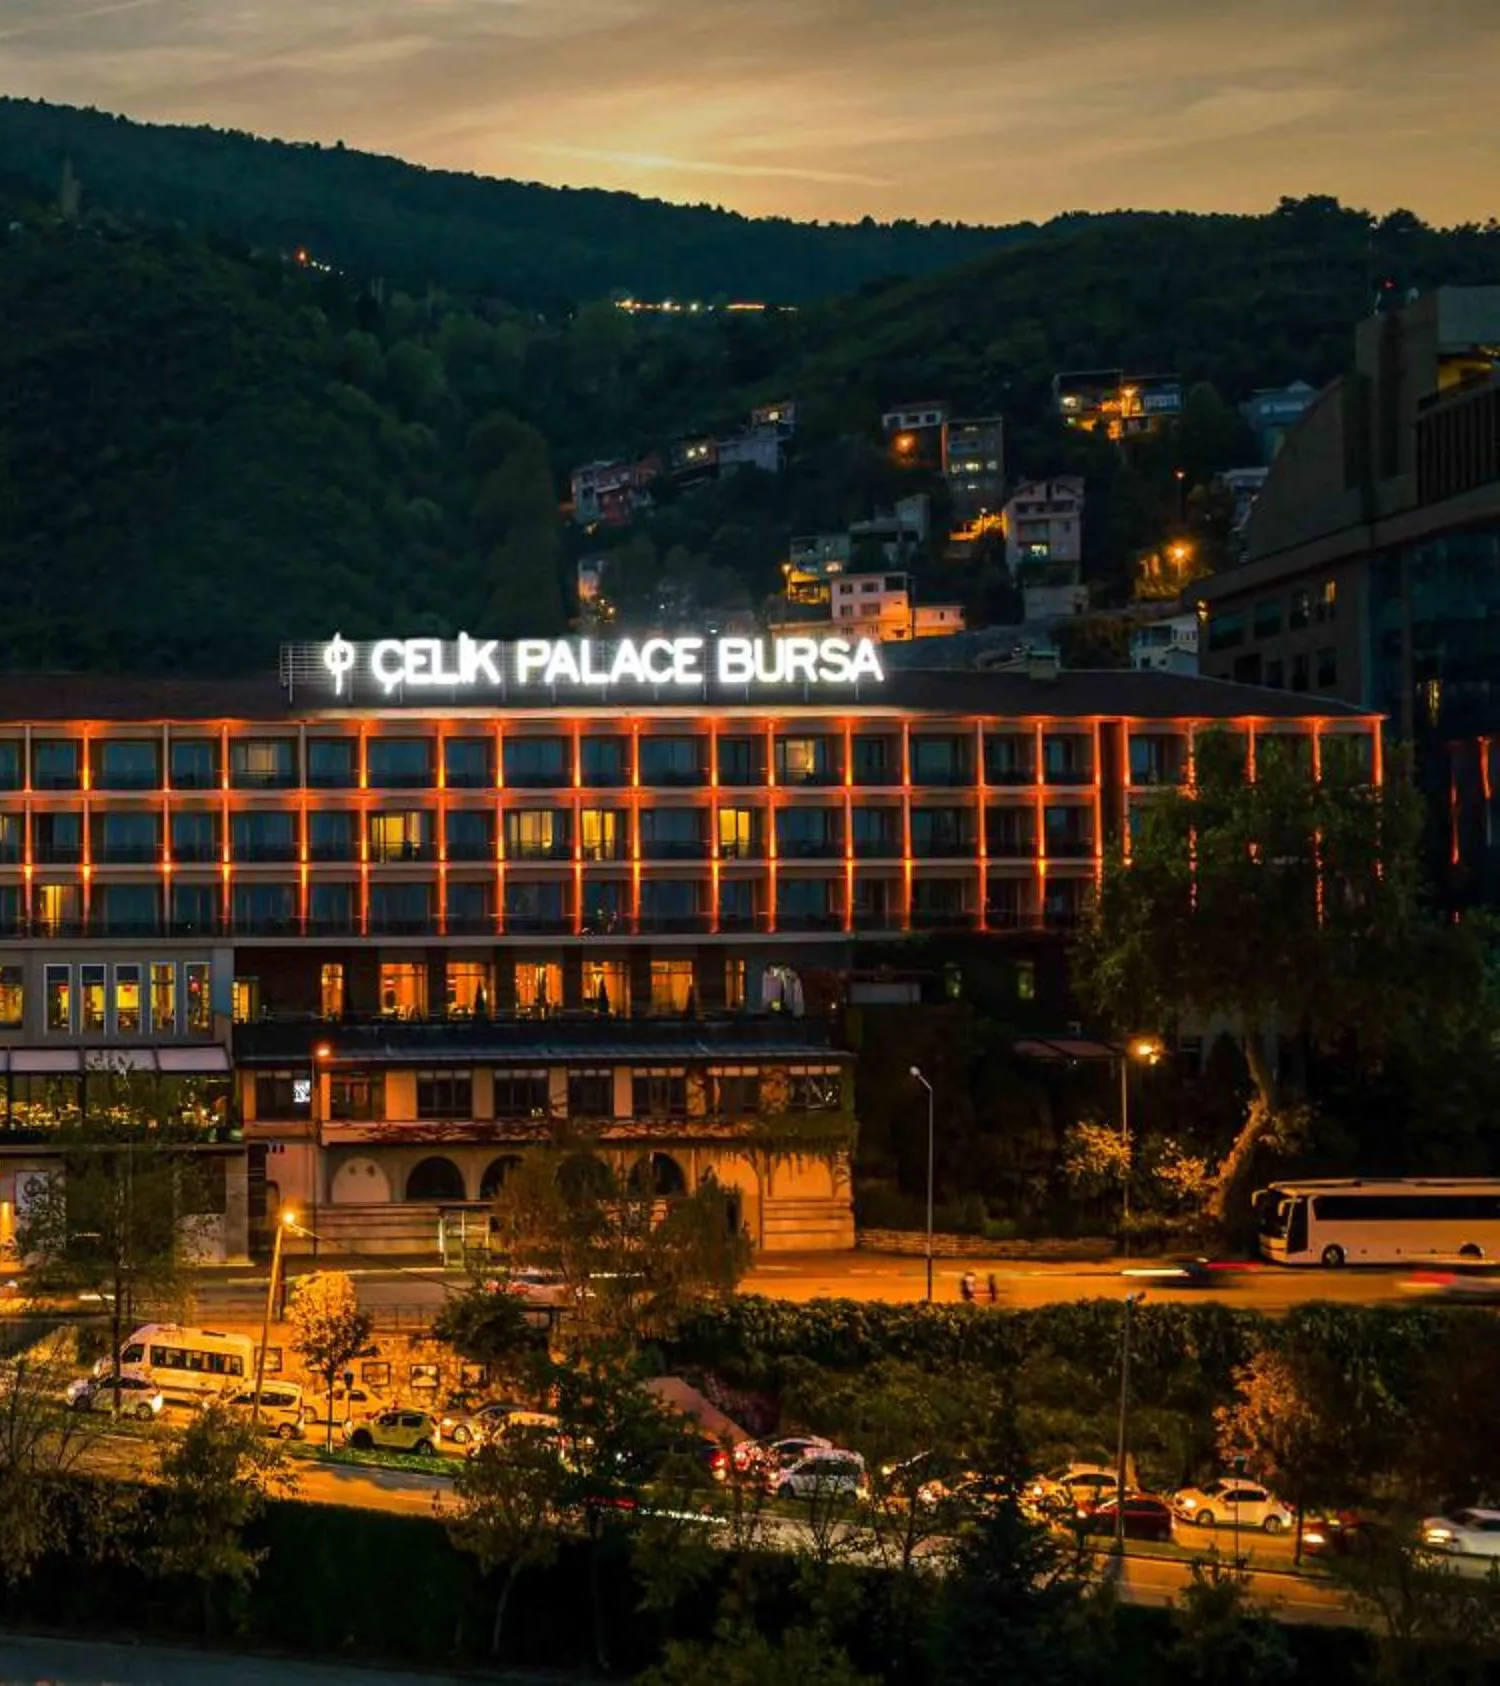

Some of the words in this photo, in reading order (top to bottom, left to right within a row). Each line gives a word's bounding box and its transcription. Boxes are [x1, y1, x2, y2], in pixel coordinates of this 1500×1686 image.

[371, 630, 502, 695] ÇELİK
[516, 637, 703, 684] PALACE
[717, 637, 885, 684] BURSA
